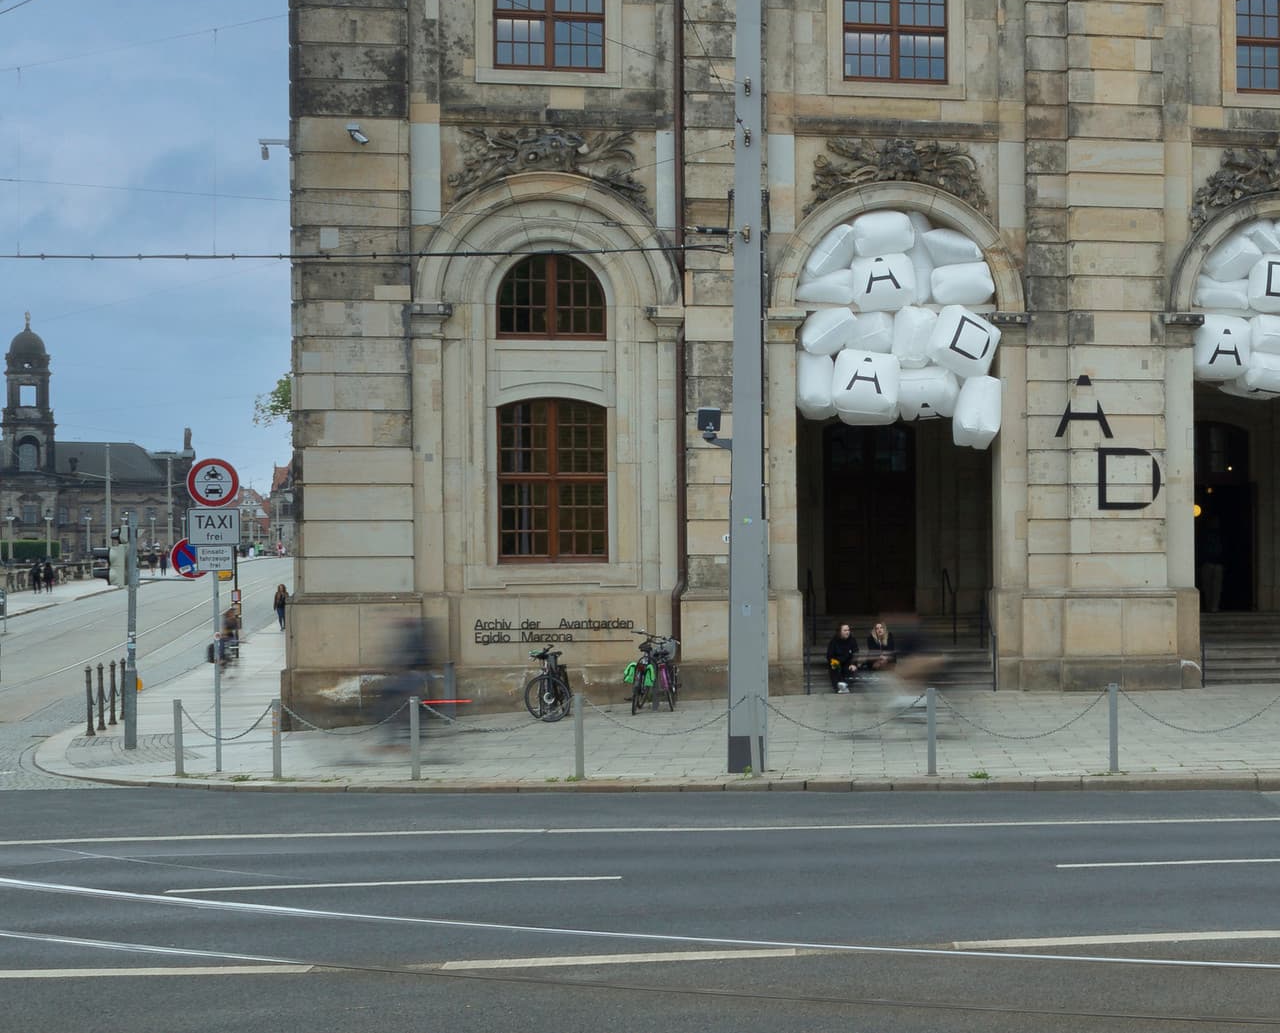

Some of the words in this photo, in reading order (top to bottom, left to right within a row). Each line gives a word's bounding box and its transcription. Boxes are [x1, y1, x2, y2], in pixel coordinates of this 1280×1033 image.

[866, 257, 901, 294] A
[949, 314, 991, 360] D
[1208, 328, 1242, 366] A
[846, 356, 882, 395] A
[1055, 375, 1114, 439] A
[1098, 447, 1161, 510] D
[194, 515, 233, 529] TAXI
[206, 532, 223, 541] frei
[474, 618, 512, 630] Archiv
[520, 618, 541, 630] der
[558, 618, 634, 631] Avantgarden
[475, 631, 511, 645] Egidio
[521, 631, 573, 643] Marzona
